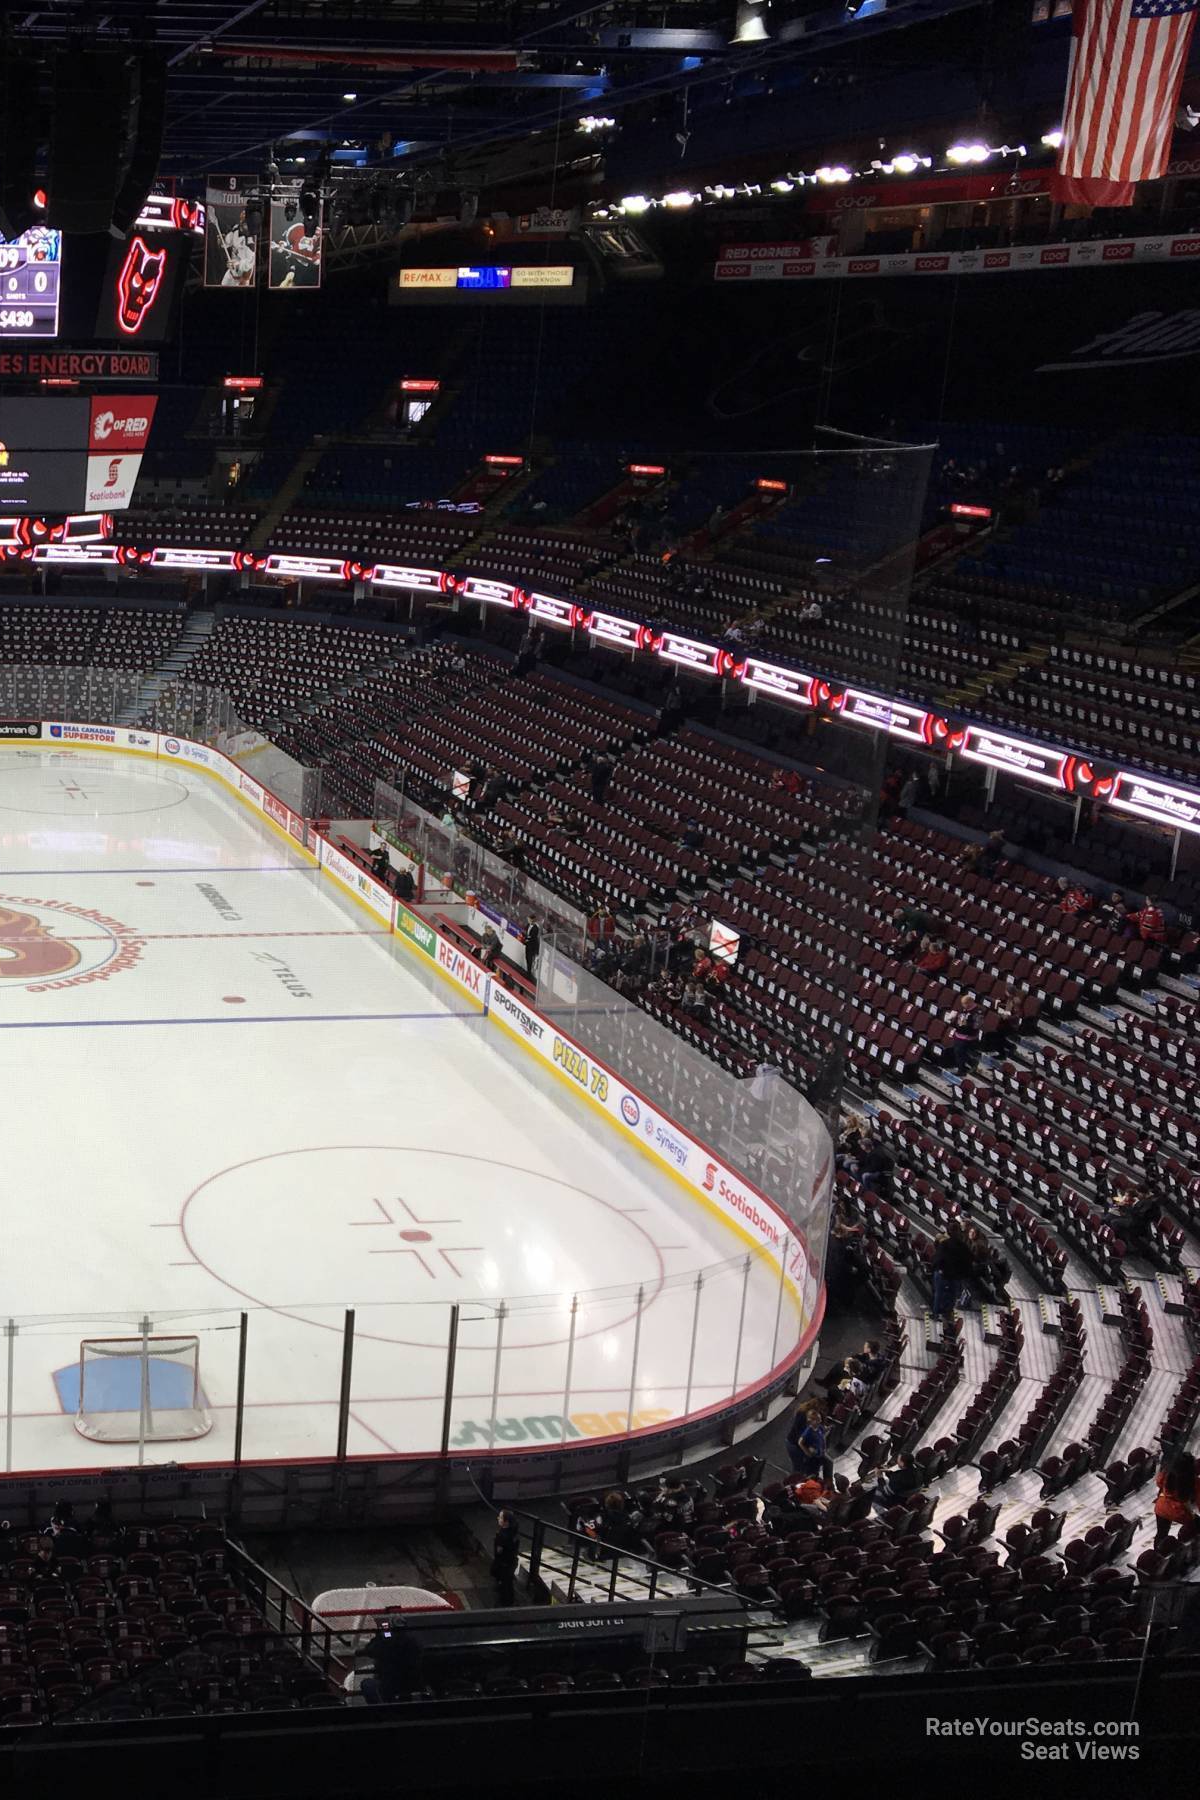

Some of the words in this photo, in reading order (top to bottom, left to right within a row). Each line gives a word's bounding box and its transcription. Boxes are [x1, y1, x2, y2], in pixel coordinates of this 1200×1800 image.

[229, 177, 237, 190] 9
[533, 215, 569, 227] HOCKEY
[725, 248, 748, 259] RED
[750, 246, 801, 258] CORNER
[34, 271, 48, 292] 0
[403, 272, 442, 283] RE/MAX
[538, 276, 561, 284] KNOW
[548, 269, 569, 277] THOSE
[8, 277, 18, 291] 0
[6, 292, 26, 300] SHOTS
[0, 310, 34, 329] $430
[28, 353, 106, 376] ENERGY
[110, 355, 151, 376] BOARD
[113, 419, 126, 431] OF
[124, 417, 148, 432] RED
[88, 490, 126, 501] Scotiabank
[63, 725, 79, 733] REAL
[81, 727, 116, 736] CANADIAN
[63, 731, 116, 743] SUPERSTORE
[401, 912, 433, 948] SUBWAY
[26, 940, 148, 994] Saddledome
[438, 941, 481, 995] RE/MAX
[272, 967, 312, 998] TELUS
[493, 989, 545, 1040] SPORTSNET
[553, 1036, 589, 1089] PIZZA
[591, 1069, 609, 1102] 73
[623, 1098, 638, 1120] Esso
[655, 1127, 688, 1166] Synergy
[718, 1179, 780, 1246] Scotiabank
[450, 1408, 673, 1446] SUBWAY
